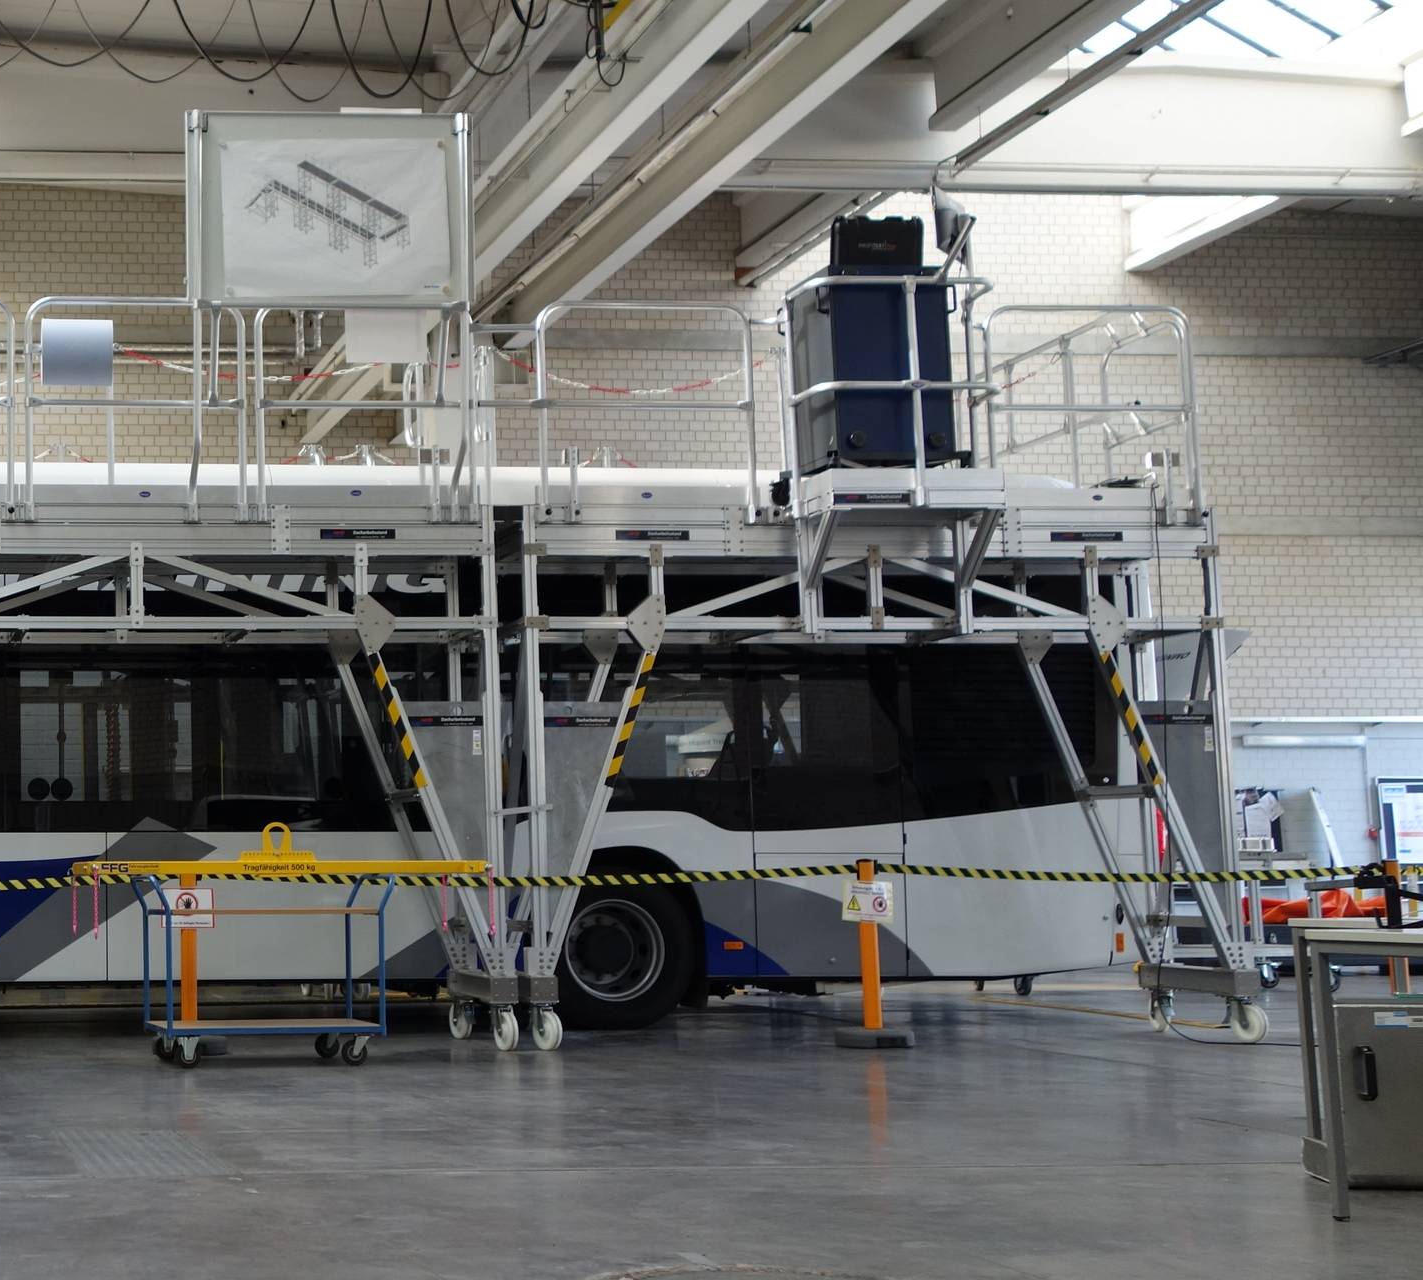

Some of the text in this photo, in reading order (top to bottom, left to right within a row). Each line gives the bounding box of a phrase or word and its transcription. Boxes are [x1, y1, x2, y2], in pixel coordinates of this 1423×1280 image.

[243, 863, 316, 872] Tragfähigkeit 500 kg
